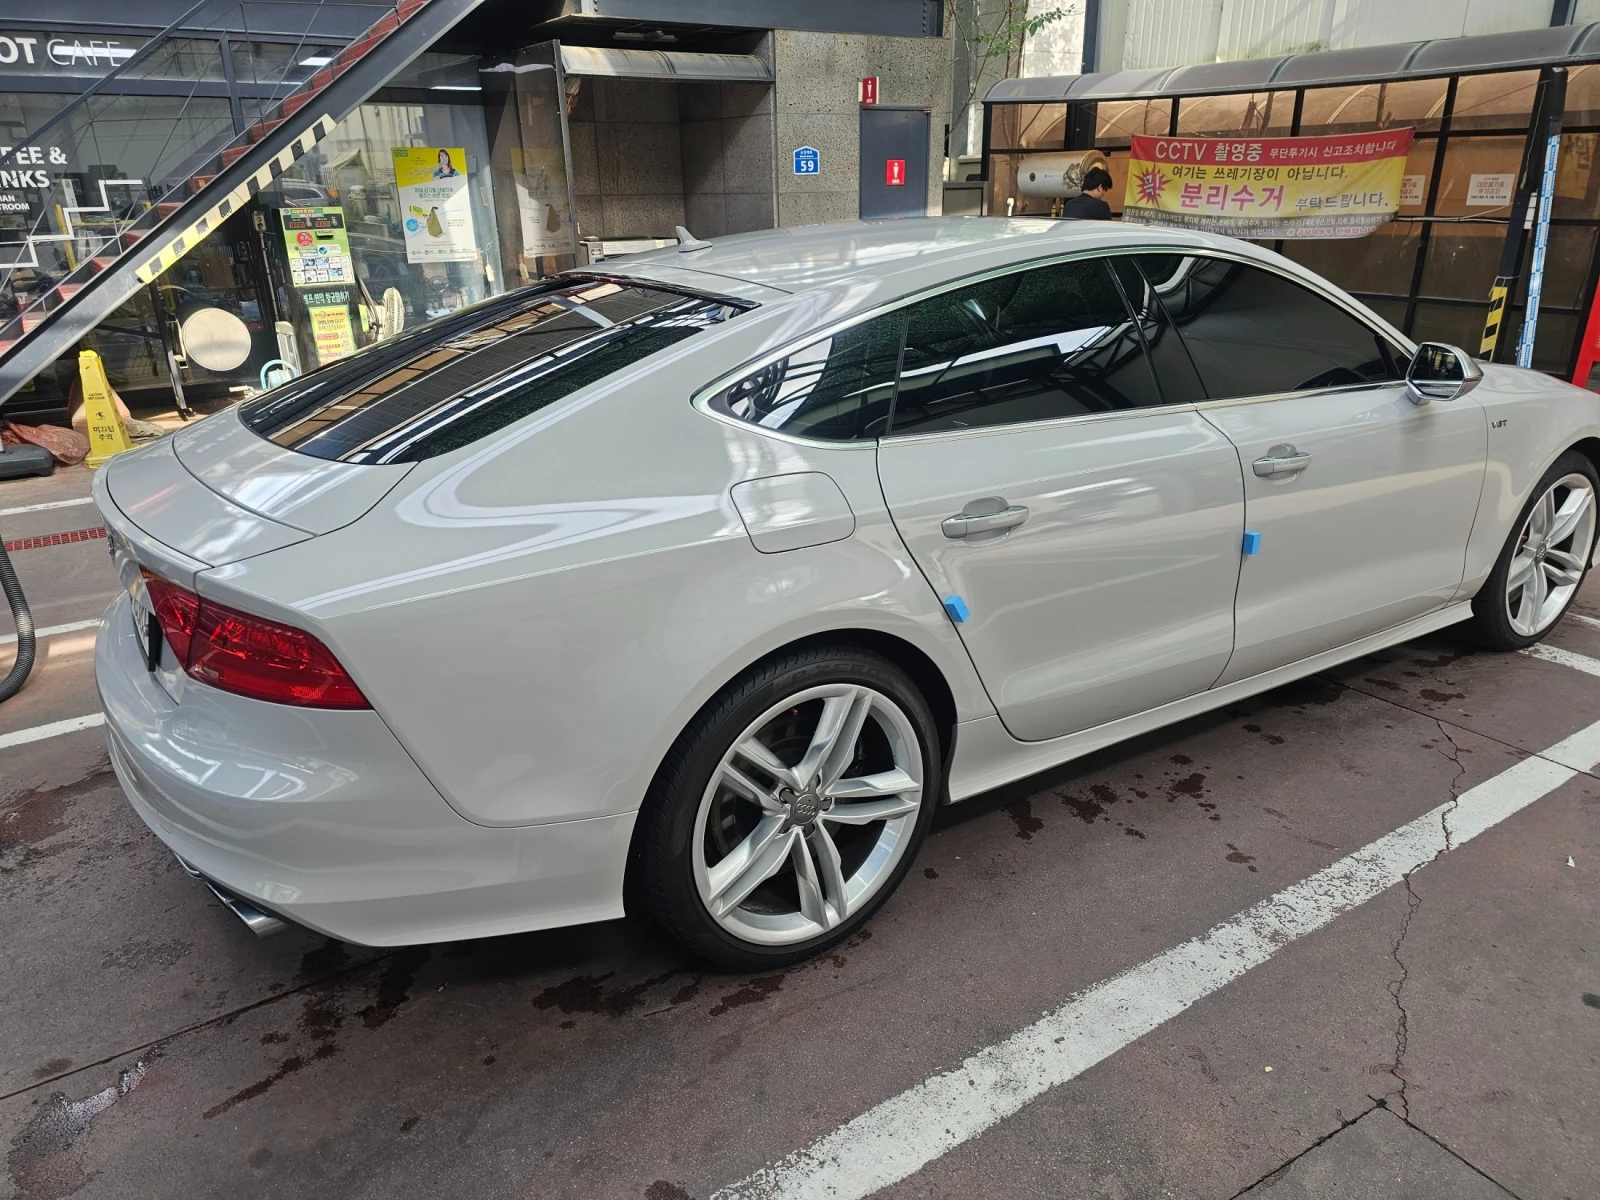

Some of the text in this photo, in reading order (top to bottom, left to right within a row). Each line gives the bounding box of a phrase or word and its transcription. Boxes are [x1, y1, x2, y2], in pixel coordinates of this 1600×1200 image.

[47, 39, 121, 66] CAFE
[49, 146, 68, 165] &
[1155, 140, 1397, 162] CCTV 촬영중 무단투기시 신고조치합니다
[800, 160, 814, 172] 59
[1172, 165, 1348, 181] 여기는 쓰레기장이 아닙니다.
[1180, 182, 1388, 212] 분리수거 부탁드립니다.
[93, 425, 115, 434] 미끄럼
[99, 433, 114, 441] 주의
